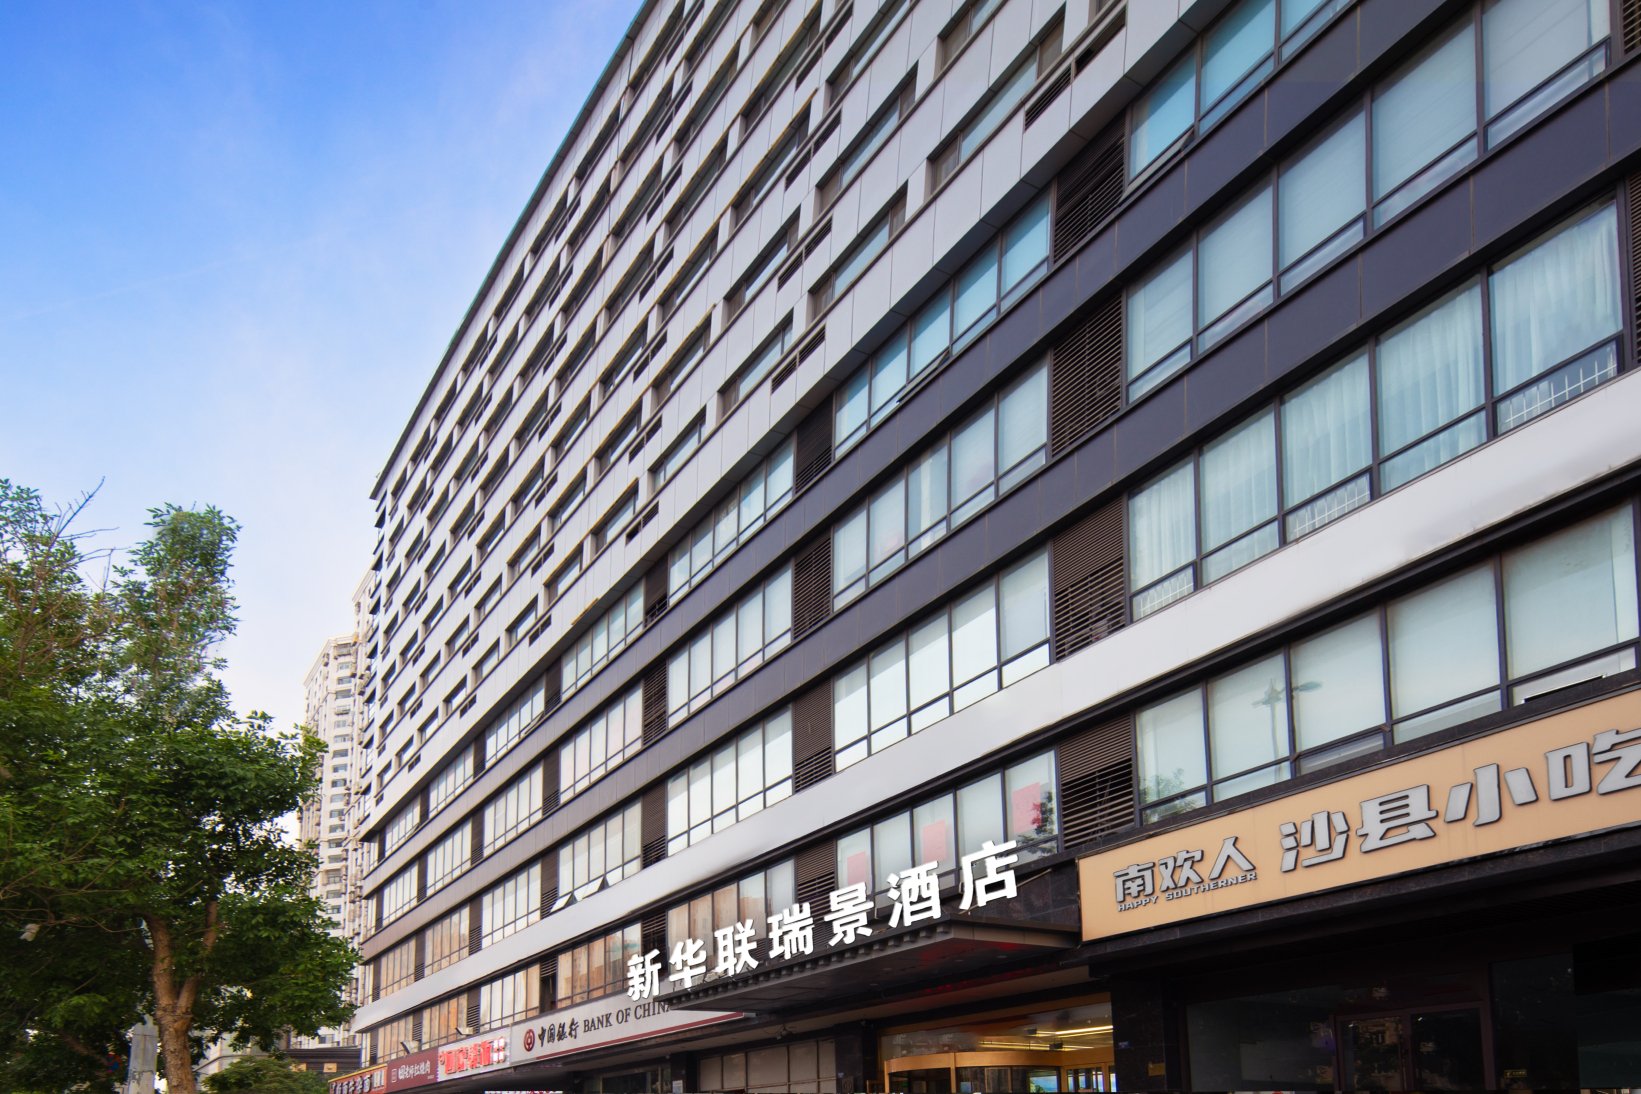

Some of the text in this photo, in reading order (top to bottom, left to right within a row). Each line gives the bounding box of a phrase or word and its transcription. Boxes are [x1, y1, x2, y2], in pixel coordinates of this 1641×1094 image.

[1279, 729, 1641, 873] 沙县小吃
[1113, 836, 1257, 904] 南欢人
[1117, 871, 1258, 912] HAPPY SOUTHERNER
[627, 840, 1019, 1002] 新华联瑞景酒店
[583, 1012, 613, 1034] BANK
[616, 1007, 631, 1025] OF
